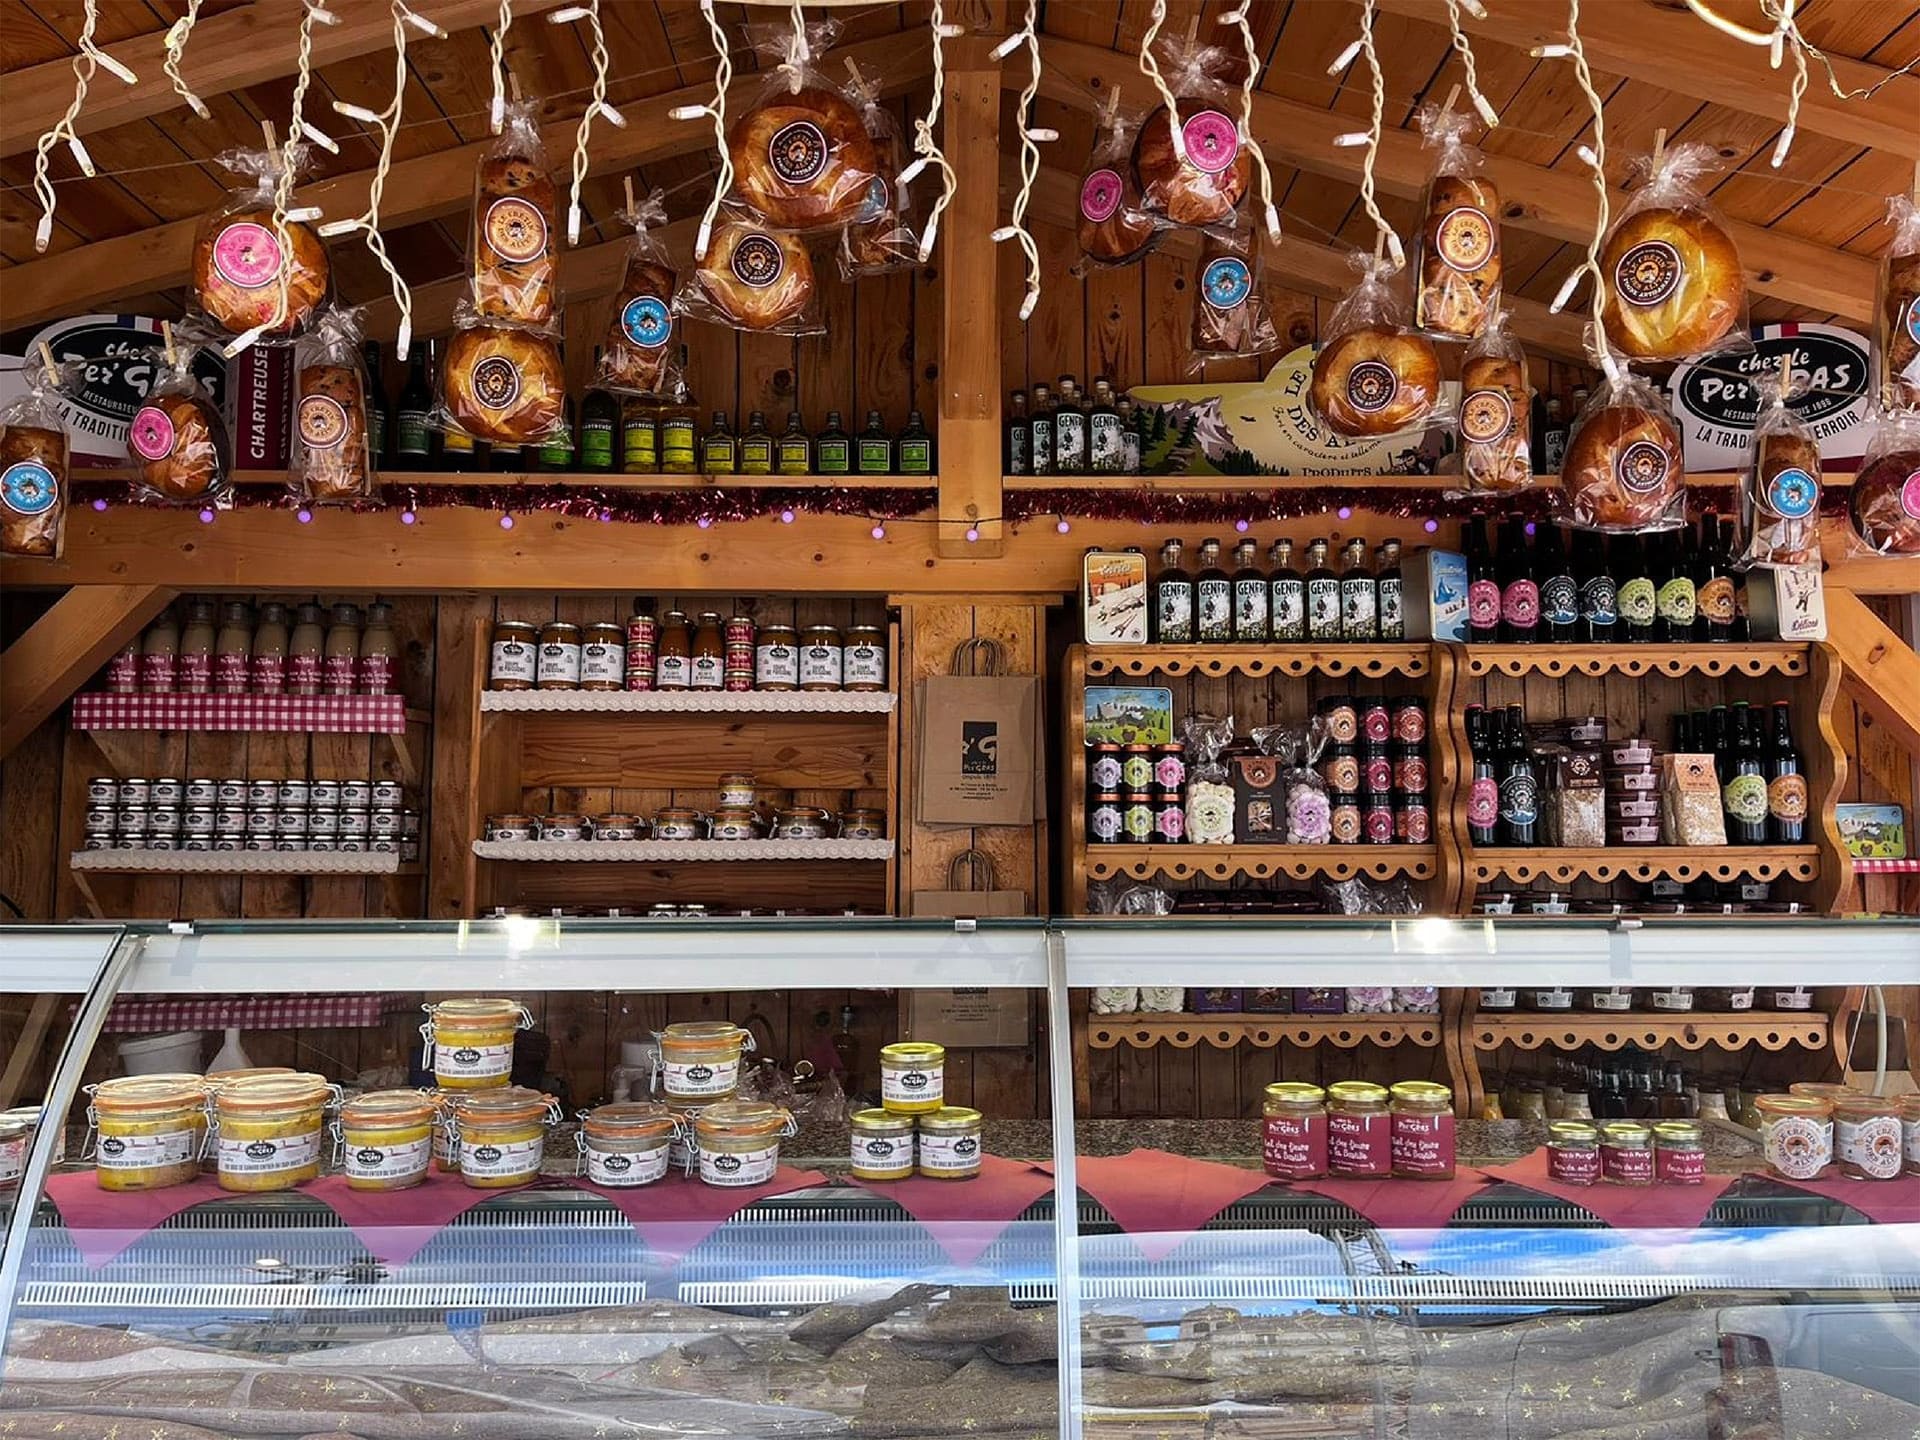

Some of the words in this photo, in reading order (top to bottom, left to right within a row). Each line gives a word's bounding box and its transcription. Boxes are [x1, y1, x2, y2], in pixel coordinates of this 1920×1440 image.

[1285, 369, 1307, 397] LE
[251, 346, 268, 459] CHARTREUSE
[72, 411, 130, 442] TRADITI
[1288, 404, 1320, 442] DES
[1695, 424, 1710, 442] LA
[1813, 410, 1860, 440] ERROIR
